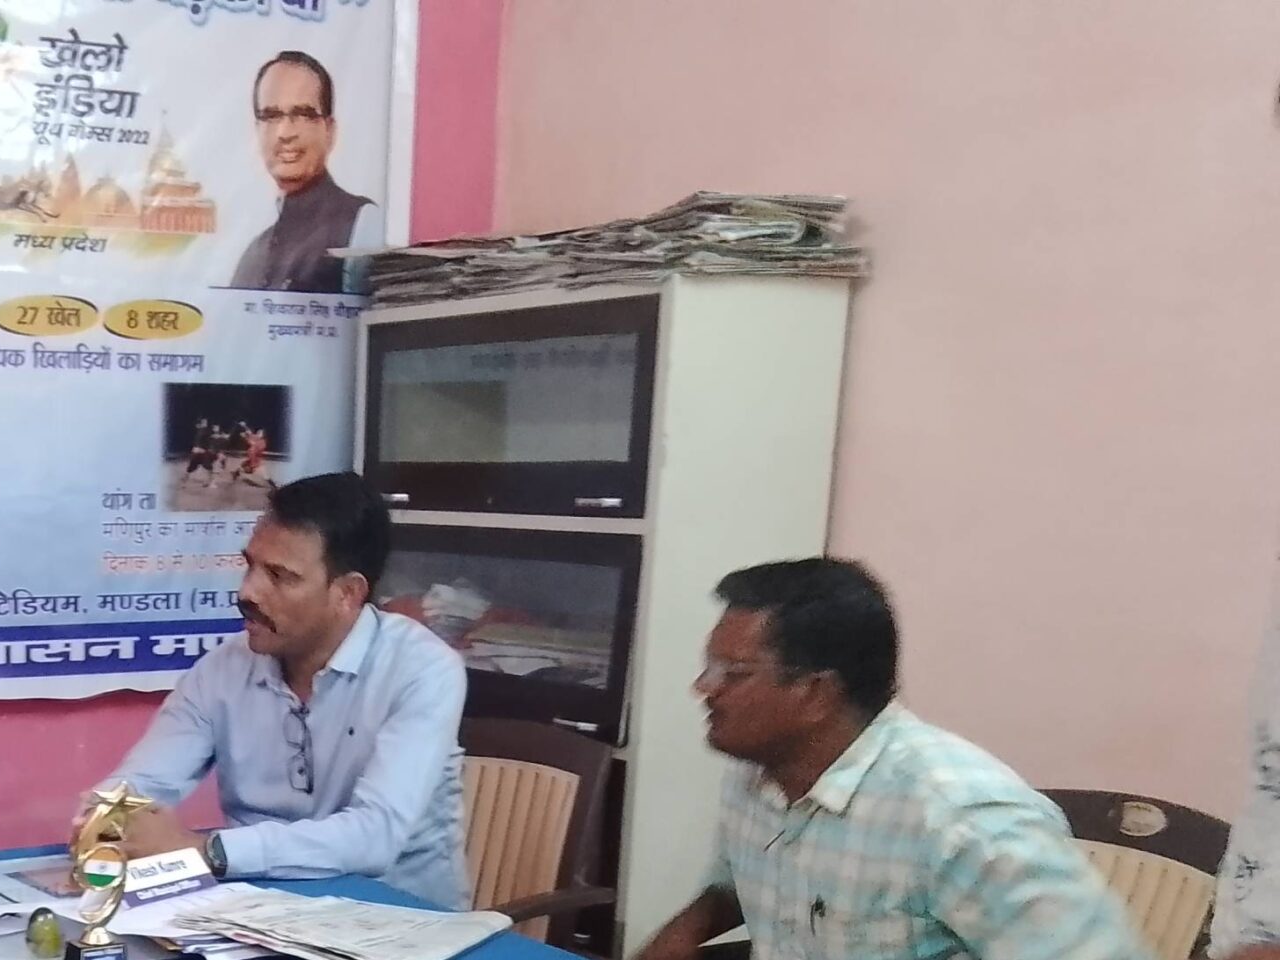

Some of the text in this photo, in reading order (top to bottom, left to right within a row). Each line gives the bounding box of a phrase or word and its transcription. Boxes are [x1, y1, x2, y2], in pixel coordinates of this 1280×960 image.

[38, 28, 129, 72] खेलो
[32, 73, 141, 118] इंडिया
[14, 232, 108, 253] मध्य प्रदेश
[16, 302, 81, 328] 27 खेल
[126, 310, 179, 330] 8 शहर
[117, 352, 140, 371] का
[147, 353, 205, 373] समागम
[102, 517, 153, 544] मणिपुर
[96, 592, 182, 612] मण्डला
